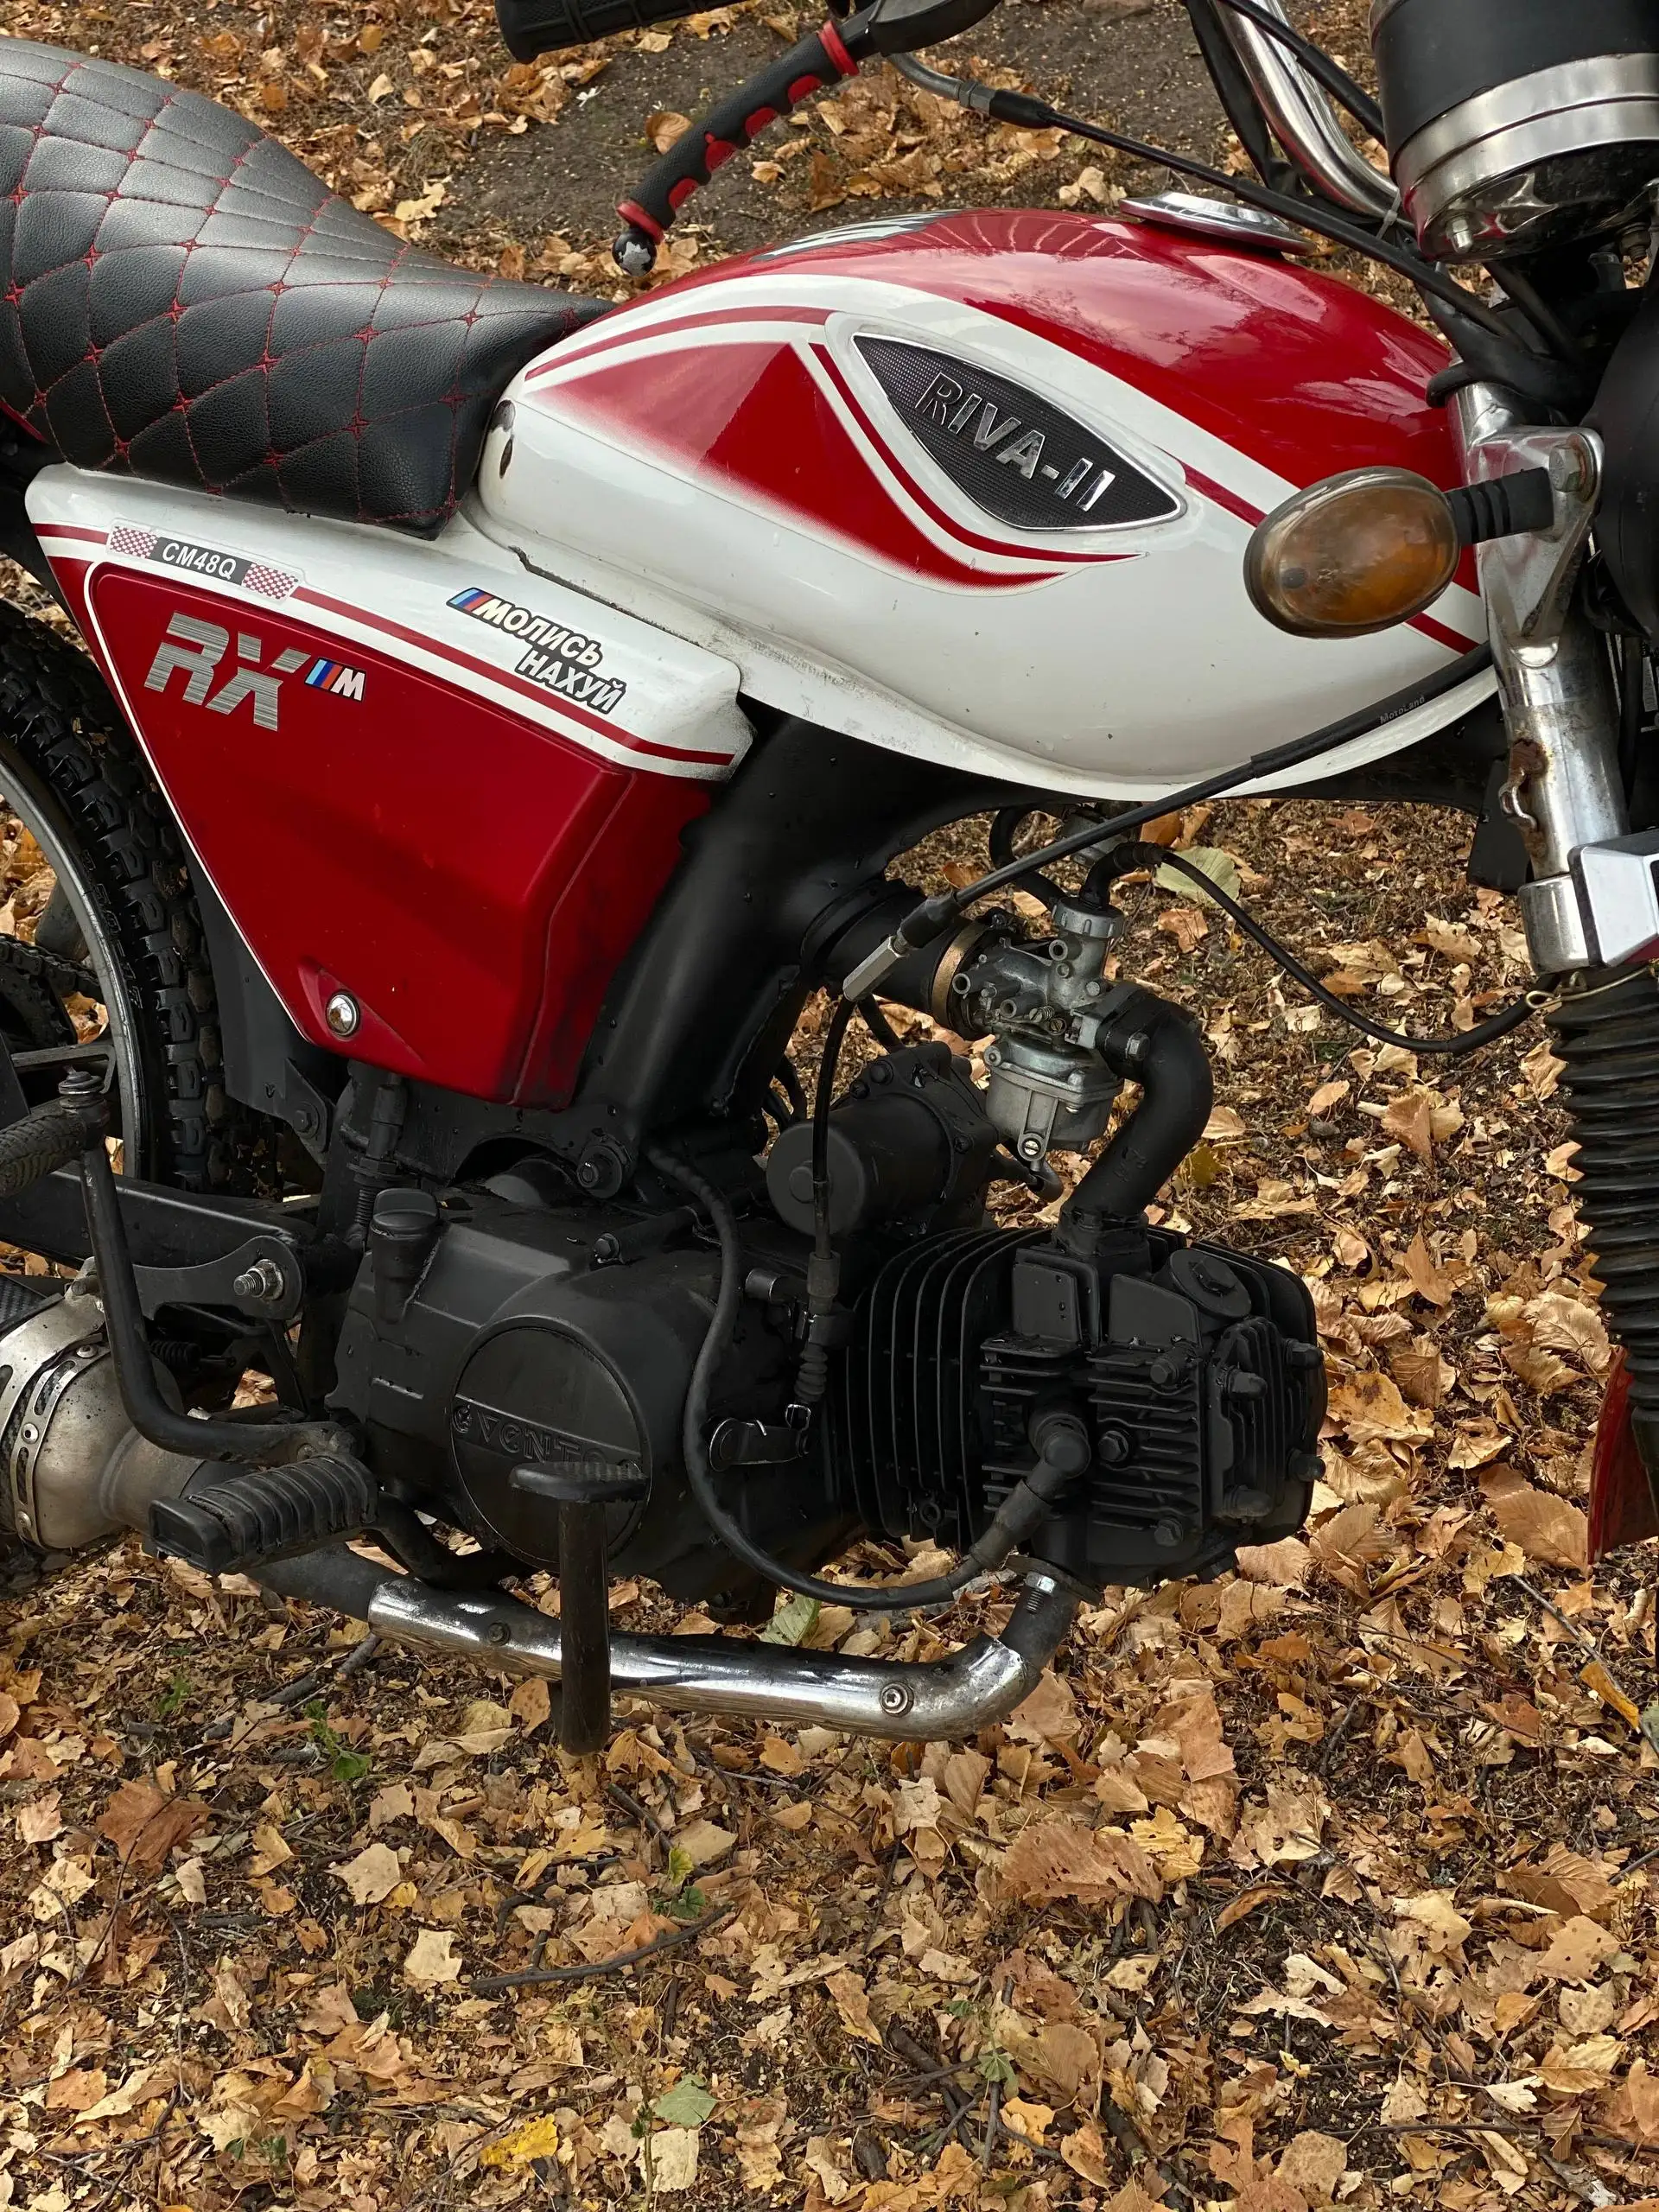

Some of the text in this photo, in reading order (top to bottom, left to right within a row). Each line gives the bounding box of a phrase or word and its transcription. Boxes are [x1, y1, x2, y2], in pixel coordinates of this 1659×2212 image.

[915, 372, 1116, 511] RIVA-II
[162, 542, 237, 579] CM48Q
[472, 599, 601, 665] МОЛИСЬ
[144, 610, 311, 731] RX
[330, 668, 365, 701] M
[518, 651, 622, 711] НАХУЙ
